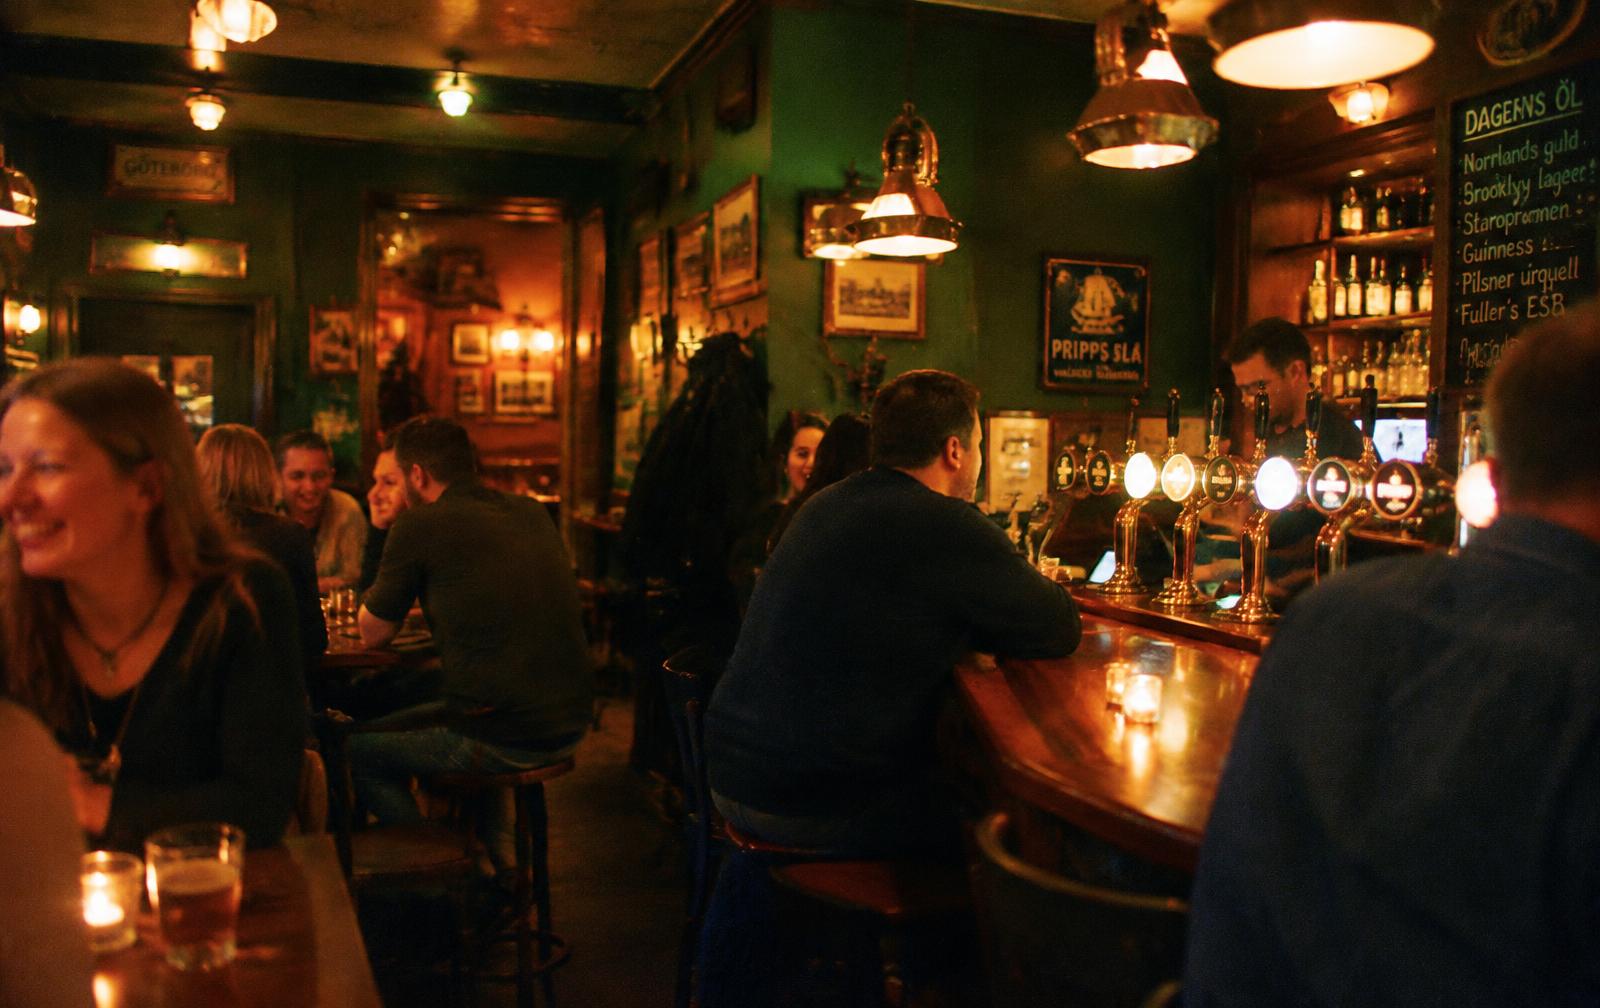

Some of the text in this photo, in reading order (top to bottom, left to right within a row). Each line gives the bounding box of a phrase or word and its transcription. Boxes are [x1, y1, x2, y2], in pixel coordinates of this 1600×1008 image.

[1555, 79, 1583, 111] ÖL
[1544, 129, 1579, 164] guld
[1463, 239, 1534, 264] Guinness
[1462, 270, 1514, 295] Pilsner
[1461, 293, 1565, 325] Fuller's ESB
